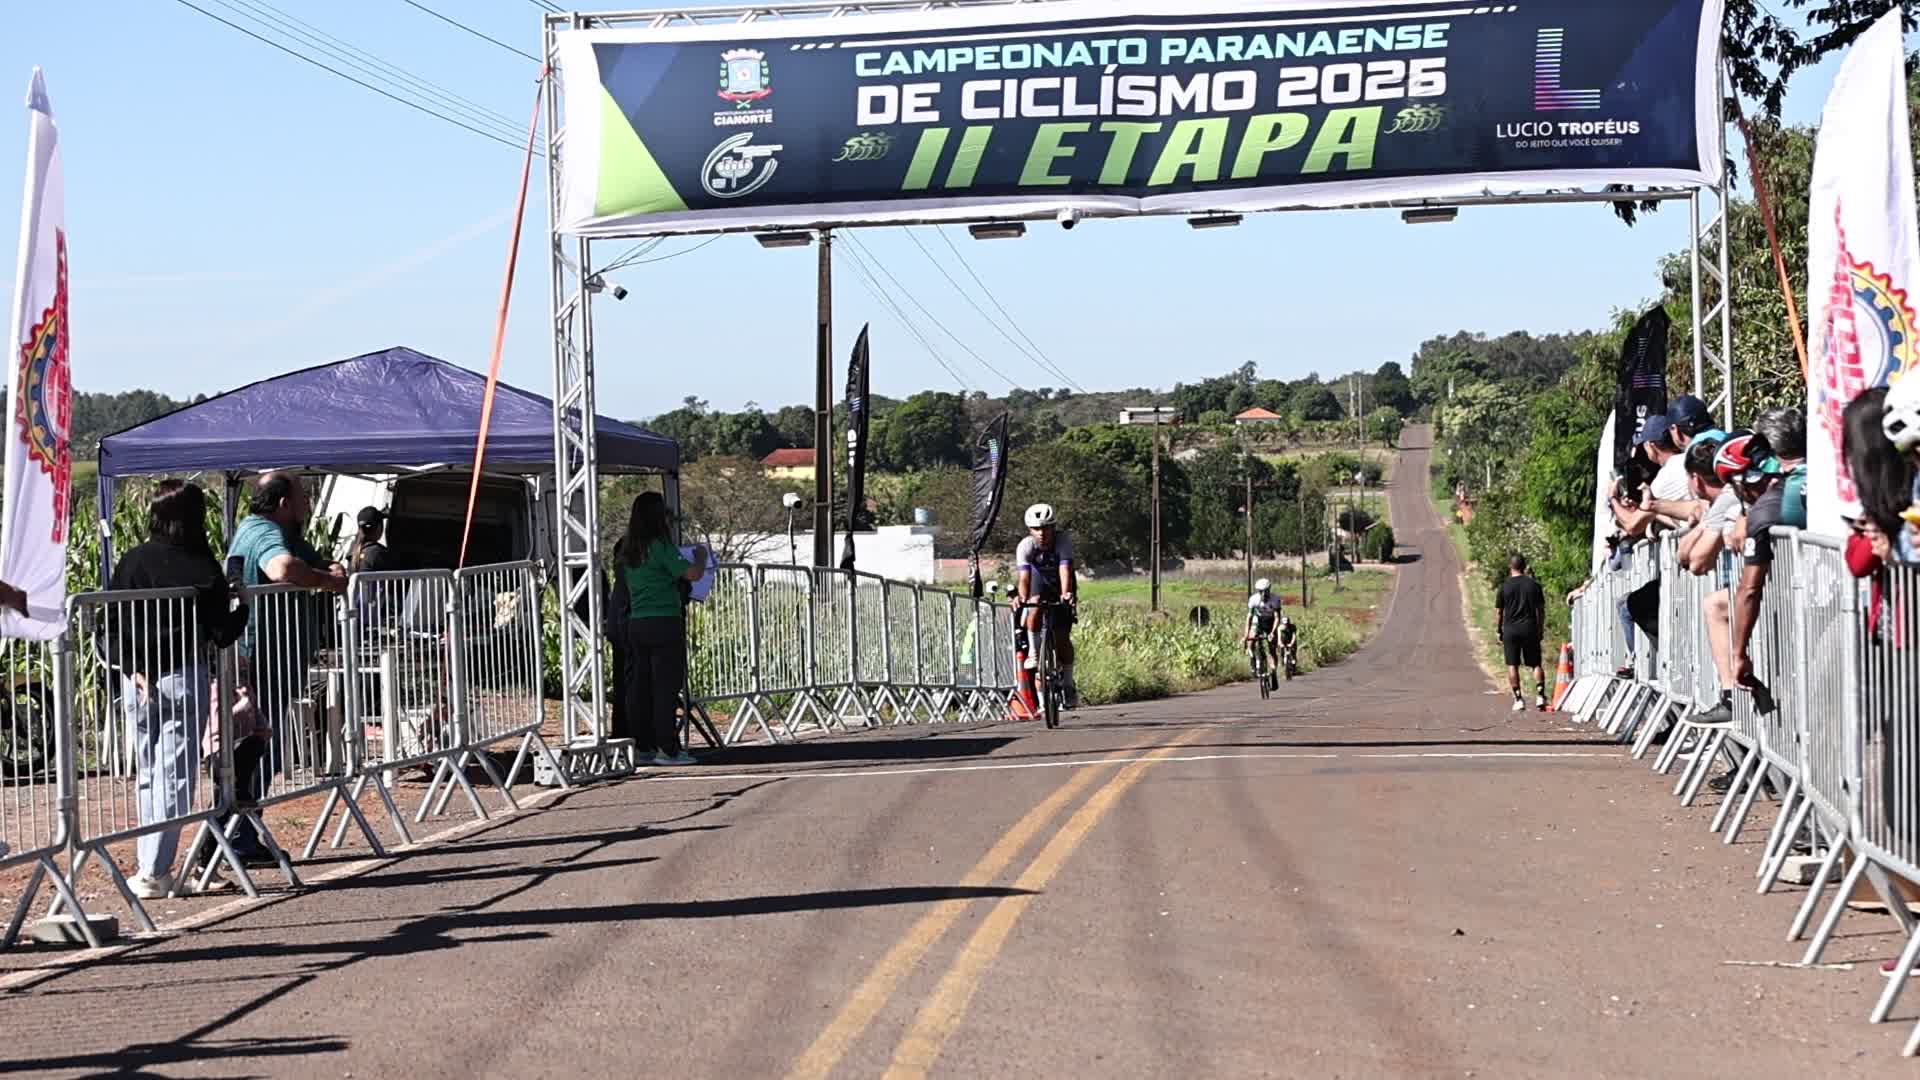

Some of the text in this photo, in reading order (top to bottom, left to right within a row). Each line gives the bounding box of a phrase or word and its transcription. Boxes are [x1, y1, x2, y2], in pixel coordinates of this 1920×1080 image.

[855, 22, 1451, 77] CAMPEONATO PARANAENSE
[856, 56, 1447, 126] DE CICLÍSMO 2026
[713, 114, 773, 126] CIANORTE
[1496, 118, 1640, 138] LUCIO TROFÉUS
[902, 106, 1384, 191] II ETAPA
